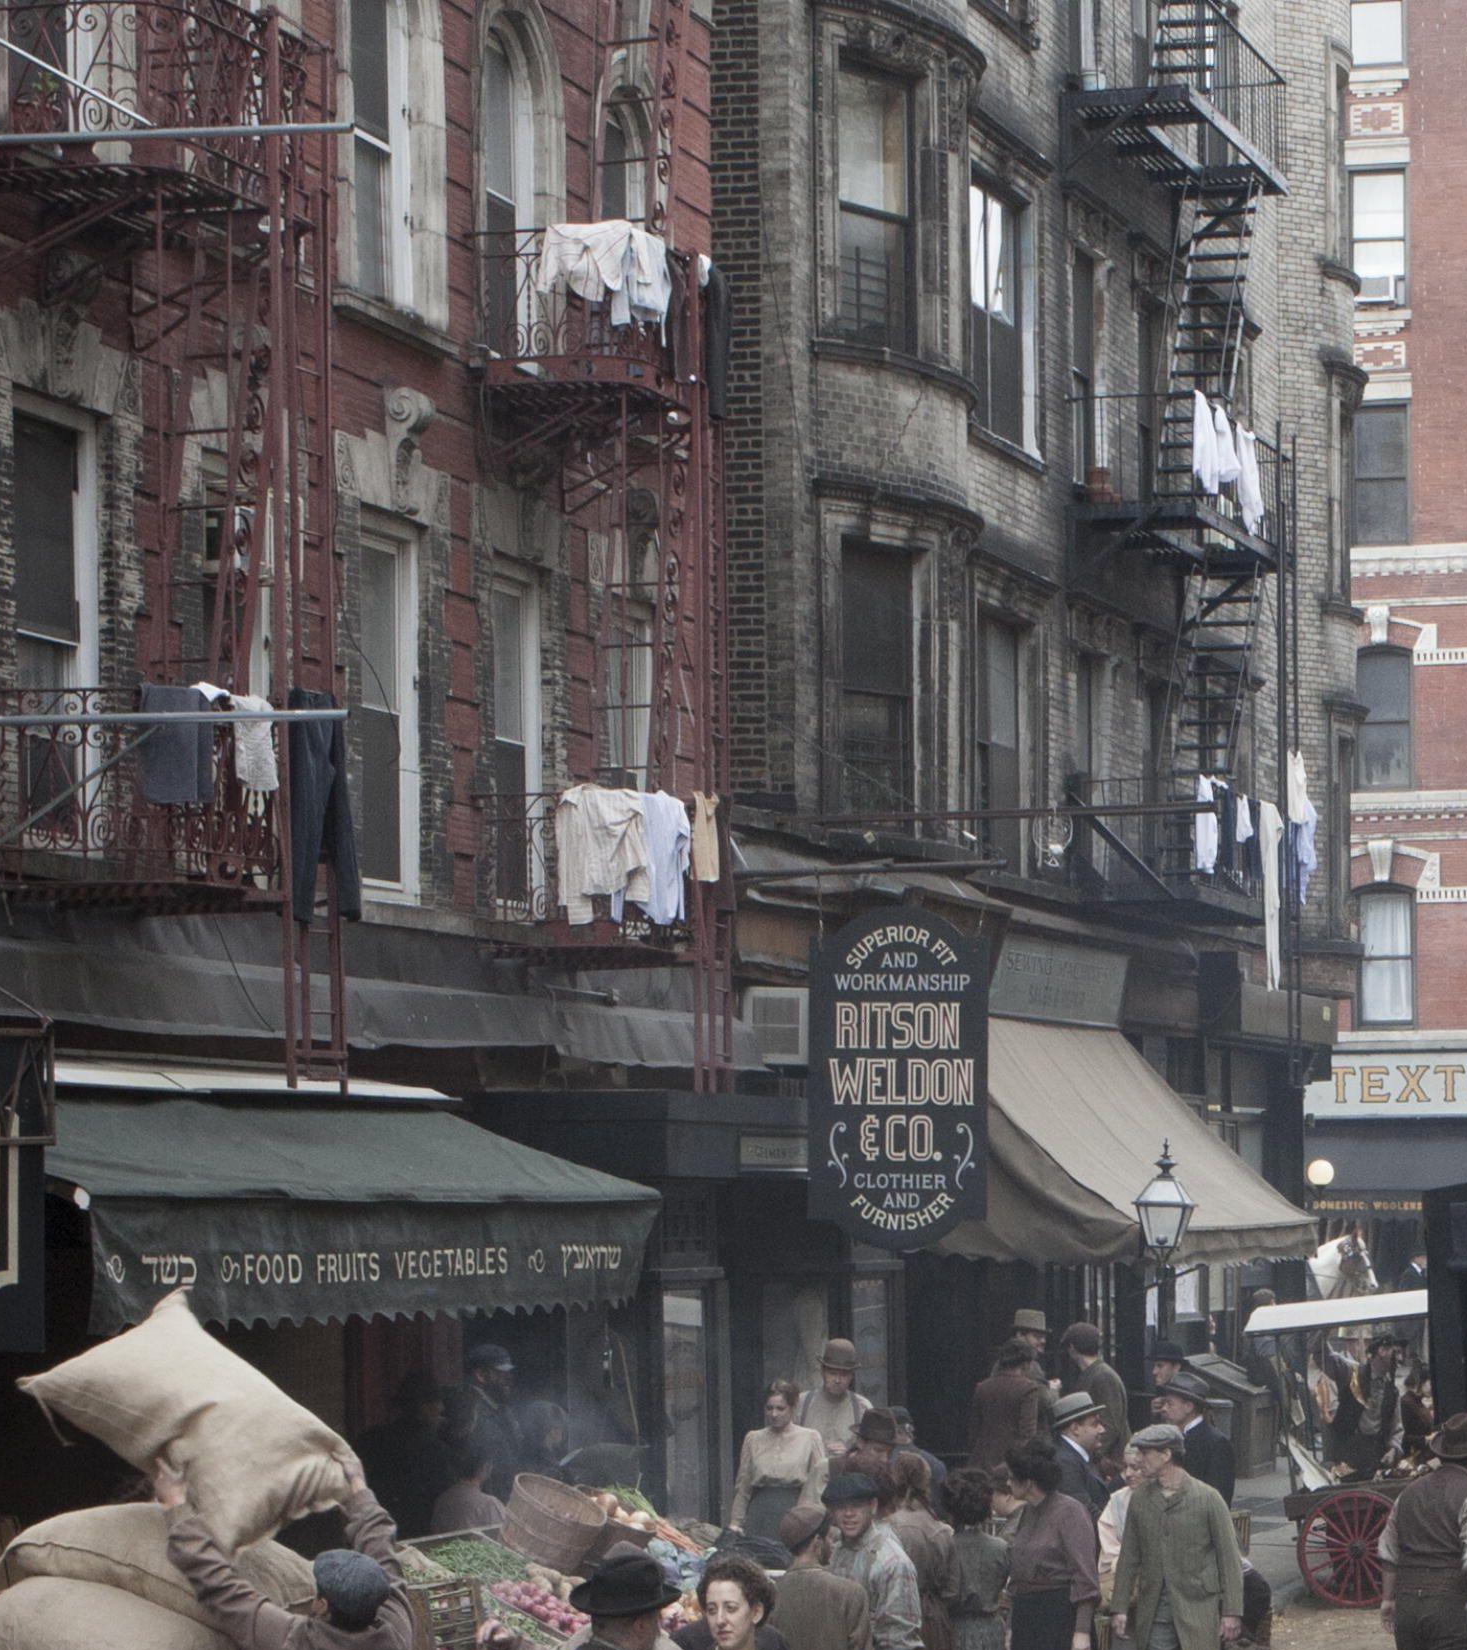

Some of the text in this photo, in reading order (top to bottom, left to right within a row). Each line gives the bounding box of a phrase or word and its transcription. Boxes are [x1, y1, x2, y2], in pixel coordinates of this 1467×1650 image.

[846, 924, 959, 970] SUPERIOR FIT
[880, 951, 919, 969] AND
[834, 973, 971, 992] WORKMANSHIP
[835, 1001, 961, 1050] RITSON
[828, 1057, 974, 1106] WELDON
[853, 1173, 947, 1190] CLOTHIER
[882, 1192, 921, 1209] AND
[849, 1191, 956, 1231] FURNISHER
[243, 1246, 509, 1285] FOOD FRUITS VEGETABLES
